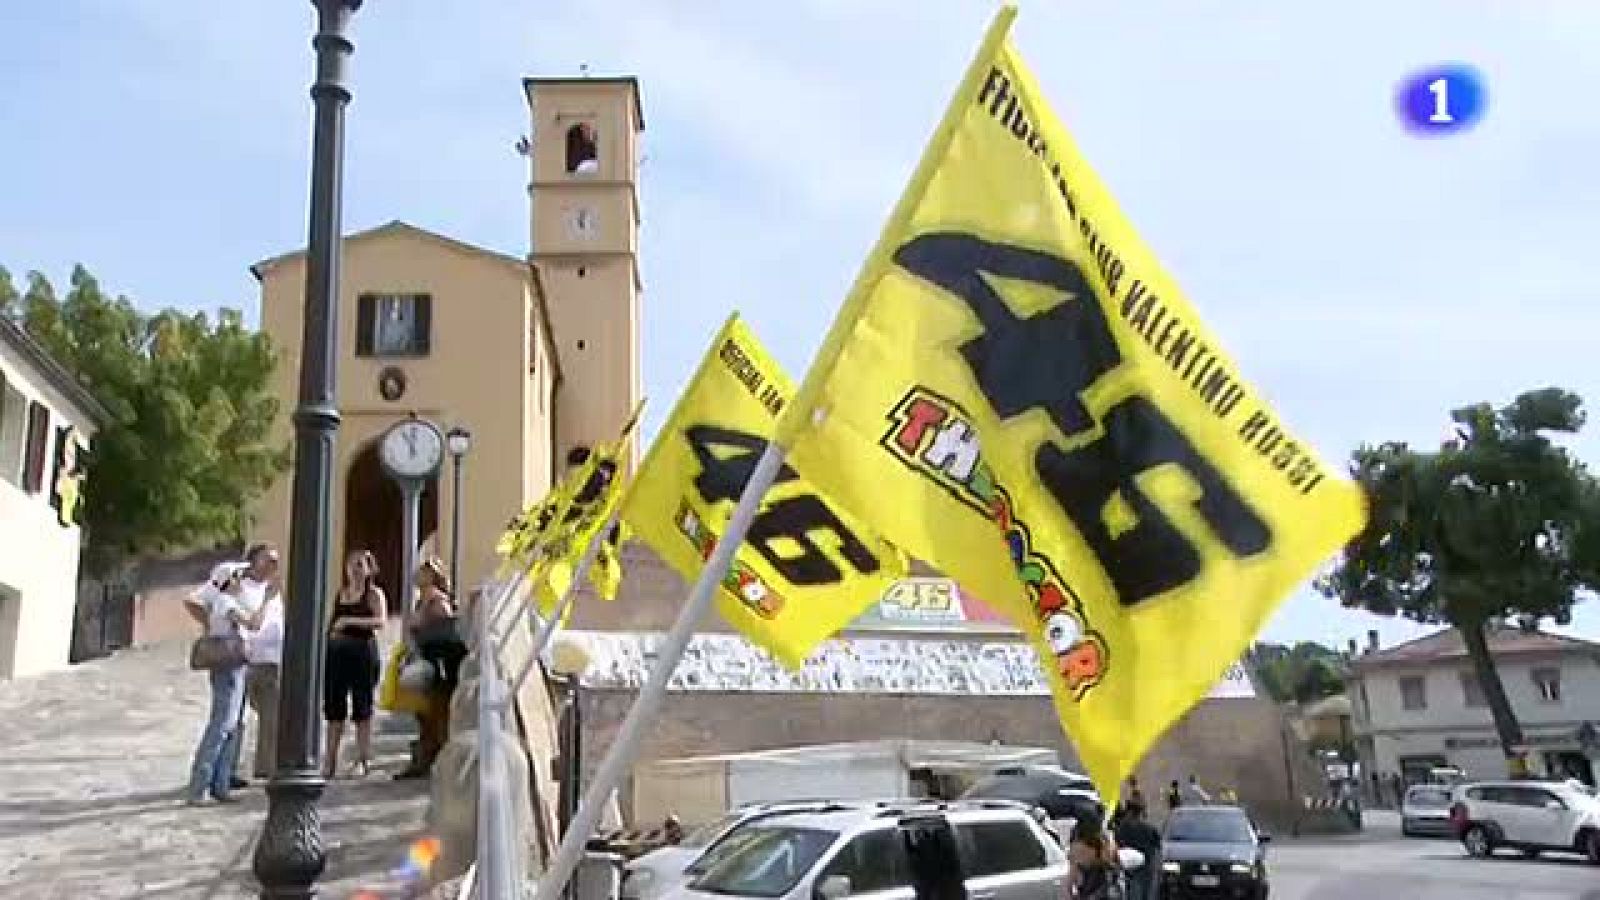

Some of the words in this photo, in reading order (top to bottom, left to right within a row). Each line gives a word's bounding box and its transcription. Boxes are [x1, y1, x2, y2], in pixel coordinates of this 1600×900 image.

[891, 230, 1274, 608] 46
[1119, 278, 1246, 418] VALENTINO
[682, 424, 881, 589] 46
[881, 581, 953, 612] 46
